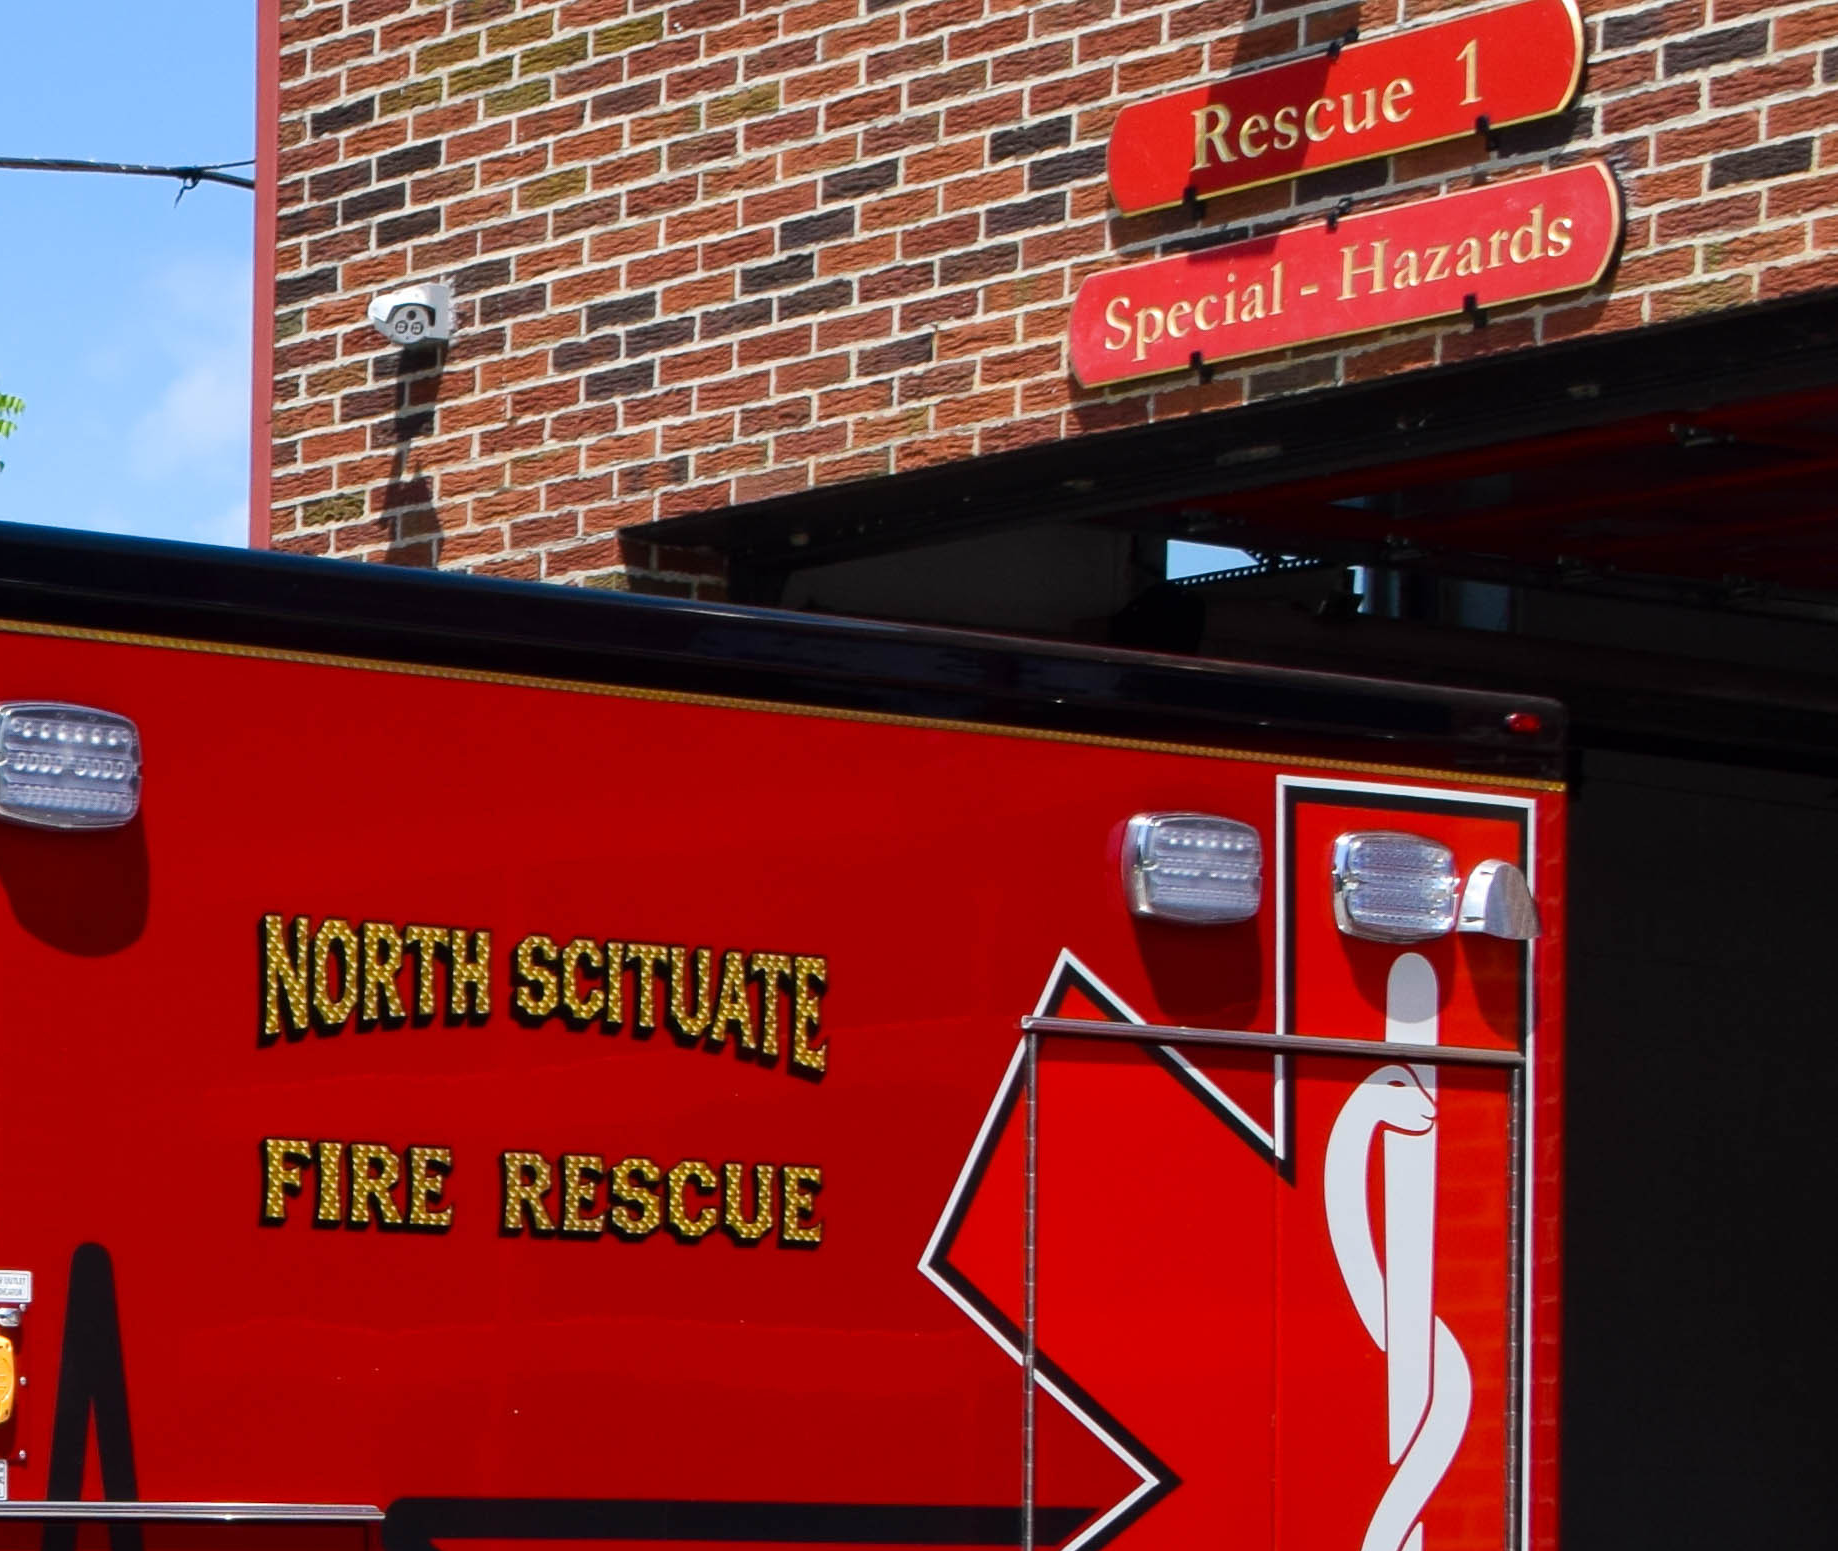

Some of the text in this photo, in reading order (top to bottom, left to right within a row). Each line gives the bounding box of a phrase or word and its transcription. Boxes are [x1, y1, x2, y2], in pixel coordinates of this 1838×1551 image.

[1189, 39, 1484, 173] Rescue 1
[1104, 260, 1284, 362] Special
[1337, 201, 1574, 303] Hazards
[258, 912, 828, 1084] NORTH SCITUATE
[259, 1136, 823, 1250] FIRE RESCUE
